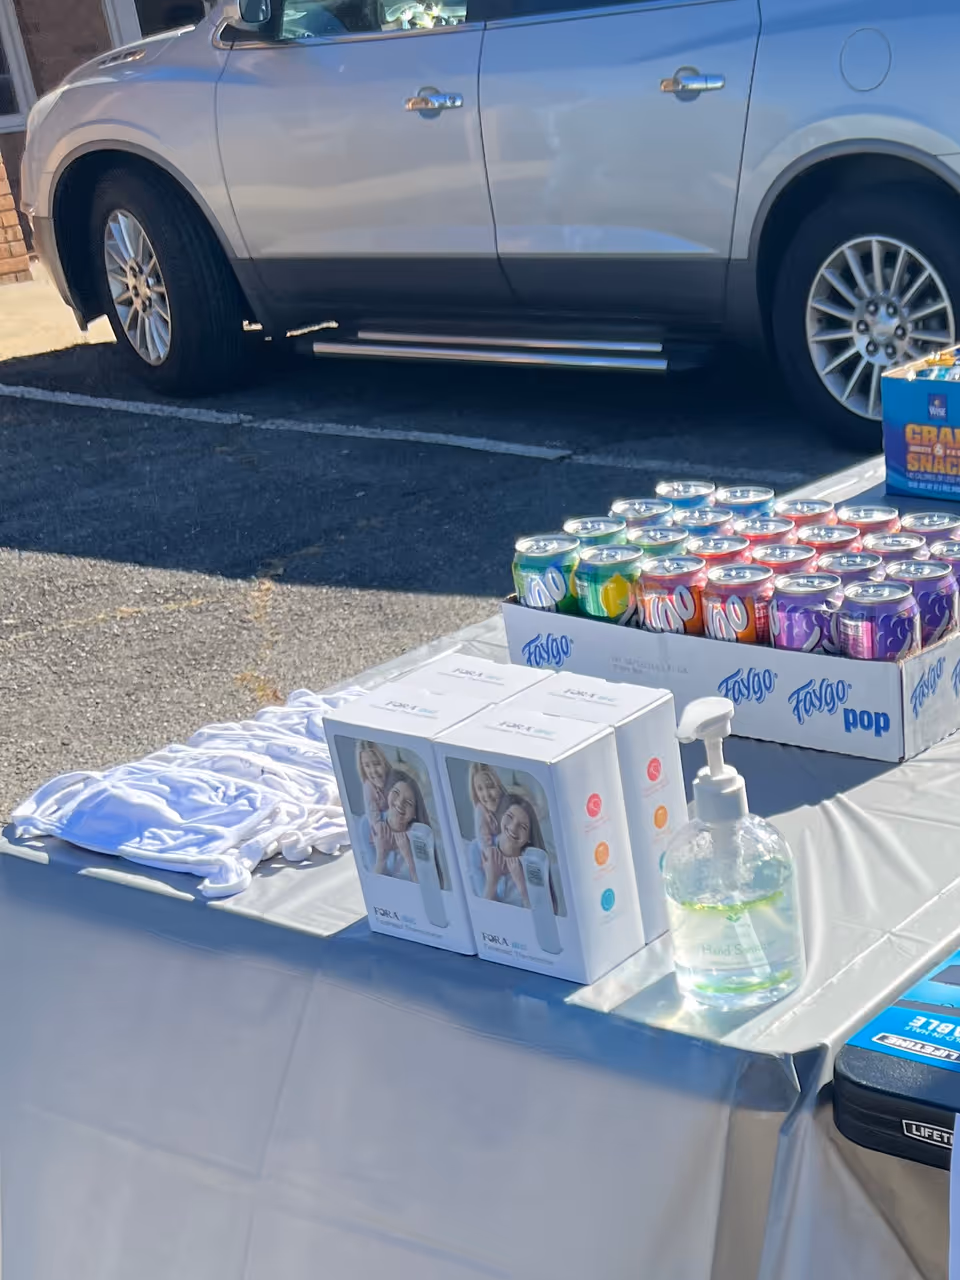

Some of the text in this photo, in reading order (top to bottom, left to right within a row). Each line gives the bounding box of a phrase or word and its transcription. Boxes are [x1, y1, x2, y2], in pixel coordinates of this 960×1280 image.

[522, 633, 571, 667] Faygo
[717, 667, 774, 705] Faygo
[910, 657, 944, 719] Faygo
[788, 678, 849, 725] Faygo
[843, 707, 890, 737] pop
[373, 906, 400, 921] FORA
[481, 932, 509, 947] FORA
[883, 1036, 960, 1061] LIFETIME
[911, 1124, 953, 1145] LIFETI
